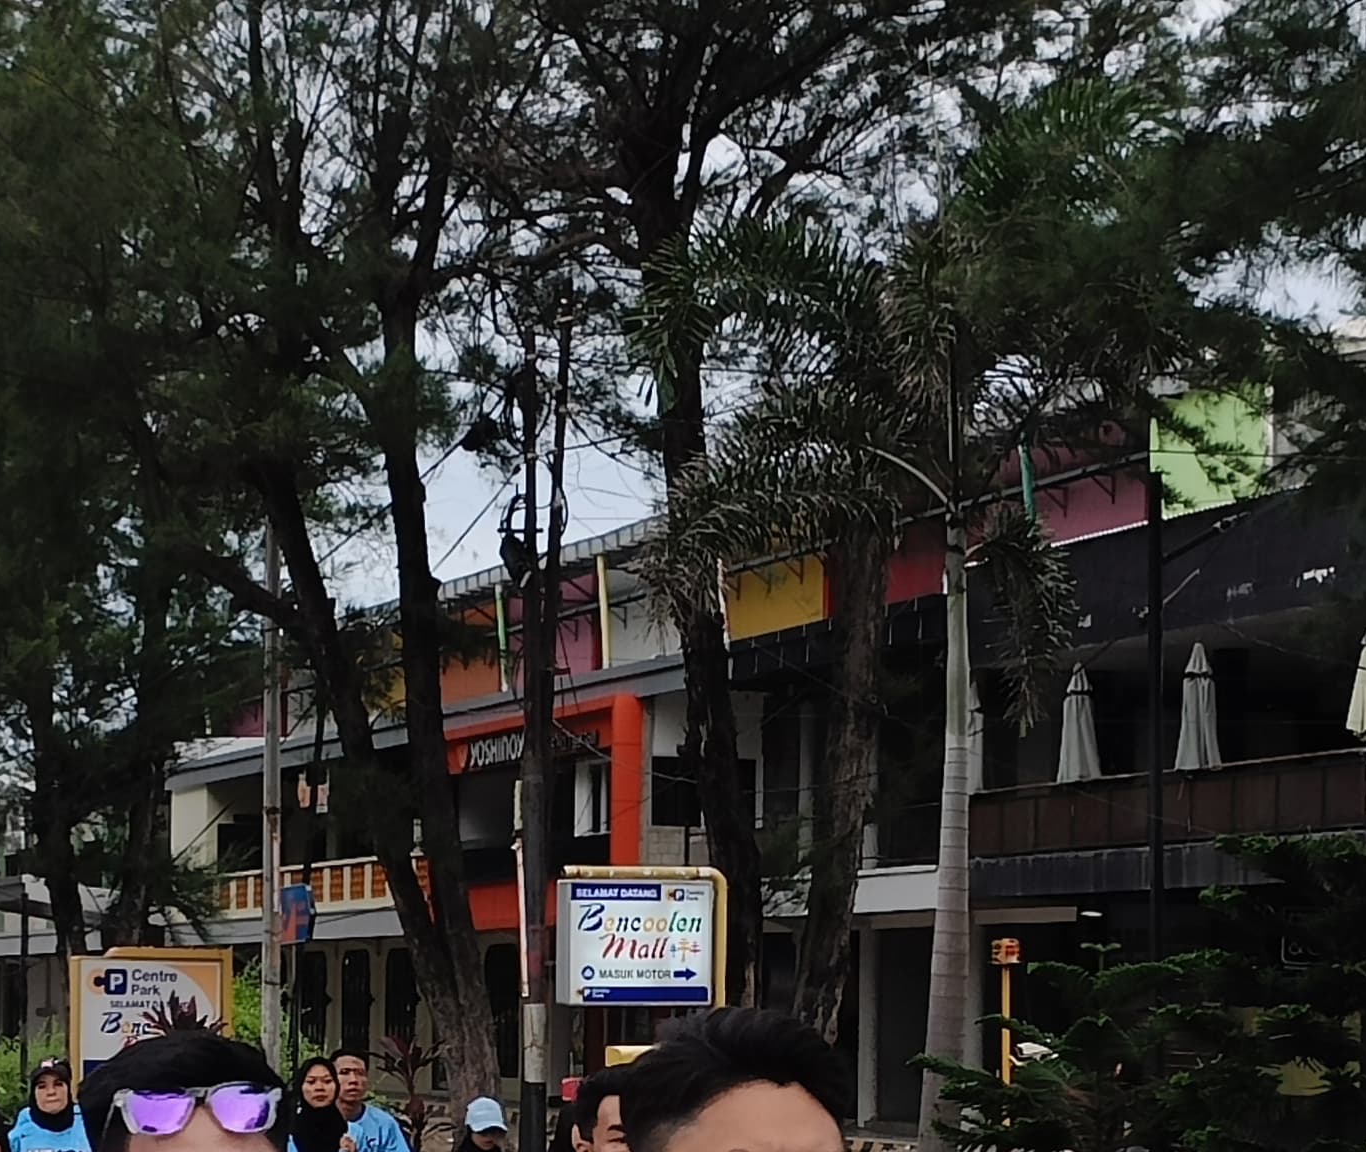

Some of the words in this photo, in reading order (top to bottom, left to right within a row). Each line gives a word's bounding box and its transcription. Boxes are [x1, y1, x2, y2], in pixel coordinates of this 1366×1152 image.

[470, 731, 524, 767] YOSHINOY
[576, 889, 617, 897] SELAMAT
[577, 903, 703, 932] Bencoolen
[599, 934, 670, 960] Mall
[131, 968, 178, 983] Centre
[599, 969, 634, 979] MASUK
[636, 969, 672, 979] MOTOR
[131, 984, 161, 996] Park
[101, 1012, 150, 1034] Benc
